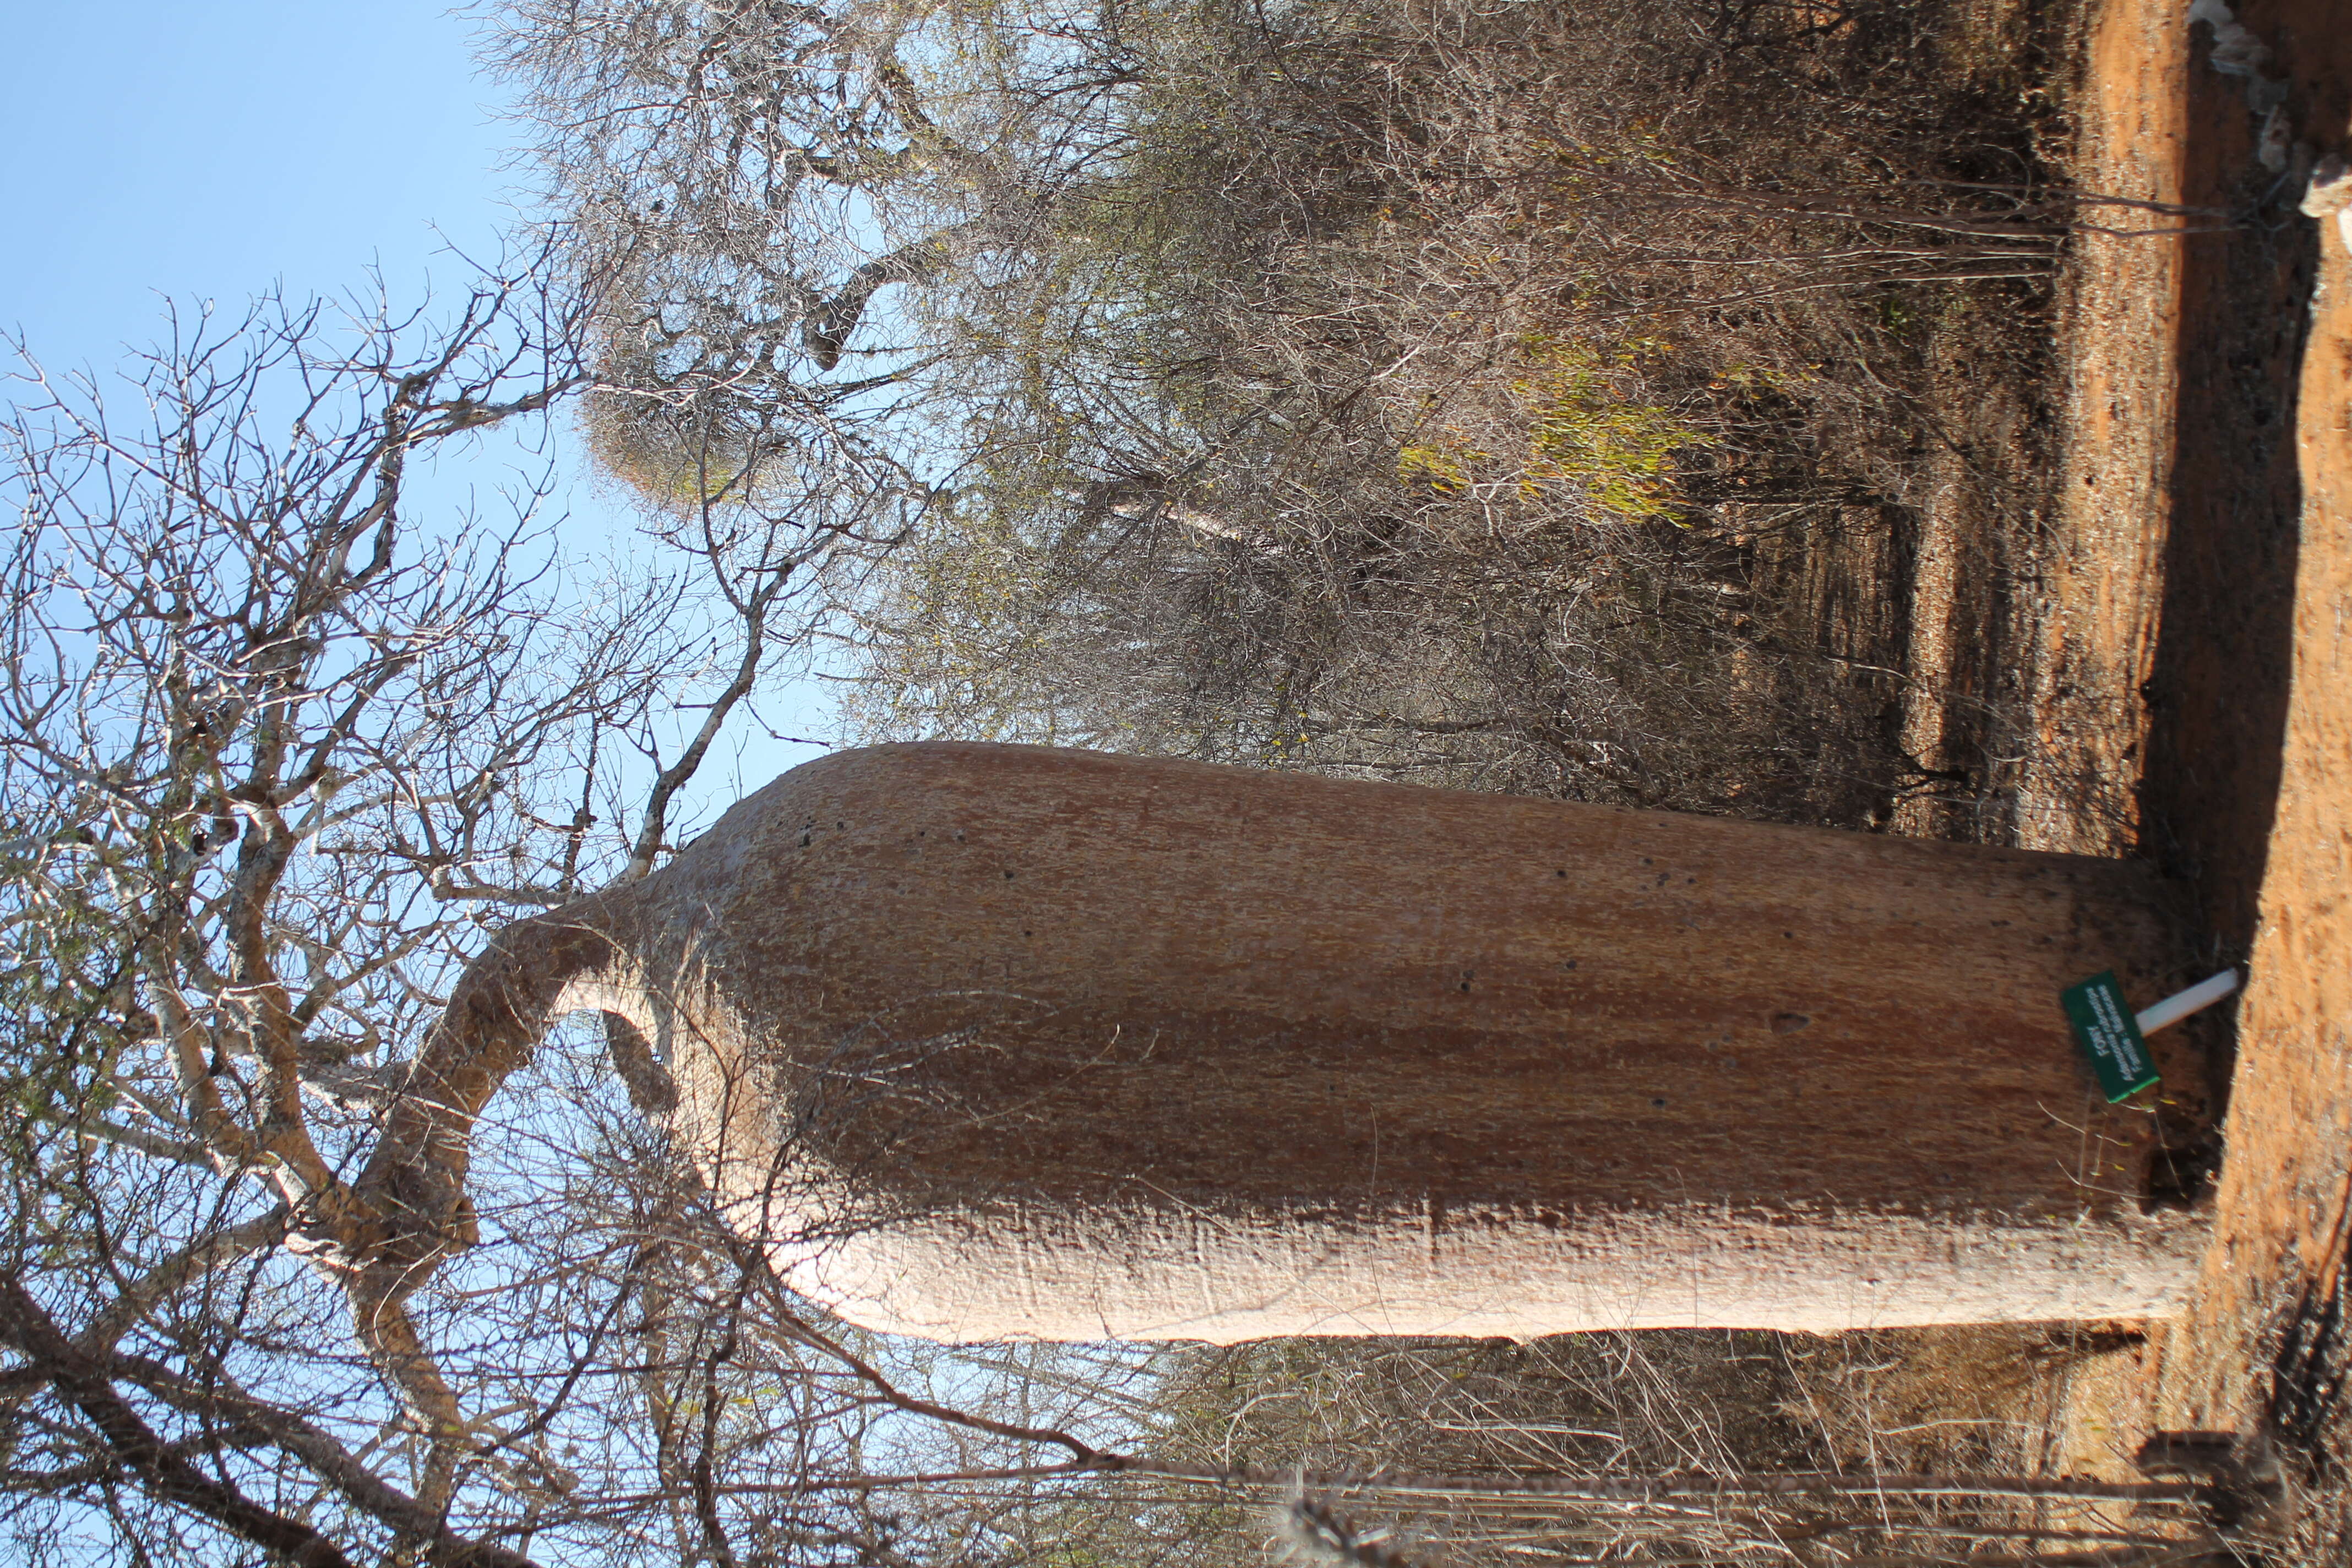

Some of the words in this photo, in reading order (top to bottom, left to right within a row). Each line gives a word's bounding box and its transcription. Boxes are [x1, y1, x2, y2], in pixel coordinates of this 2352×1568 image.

[2086, 987, 2112, 1032] rubrostipa
[2098, 984, 2125, 1033] Malvaceae
[2087, 1026, 2109, 1057] FONY
[2107, 1033, 2135, 1081] Adansonia
[2122, 1038, 2142, 1072] Famille
